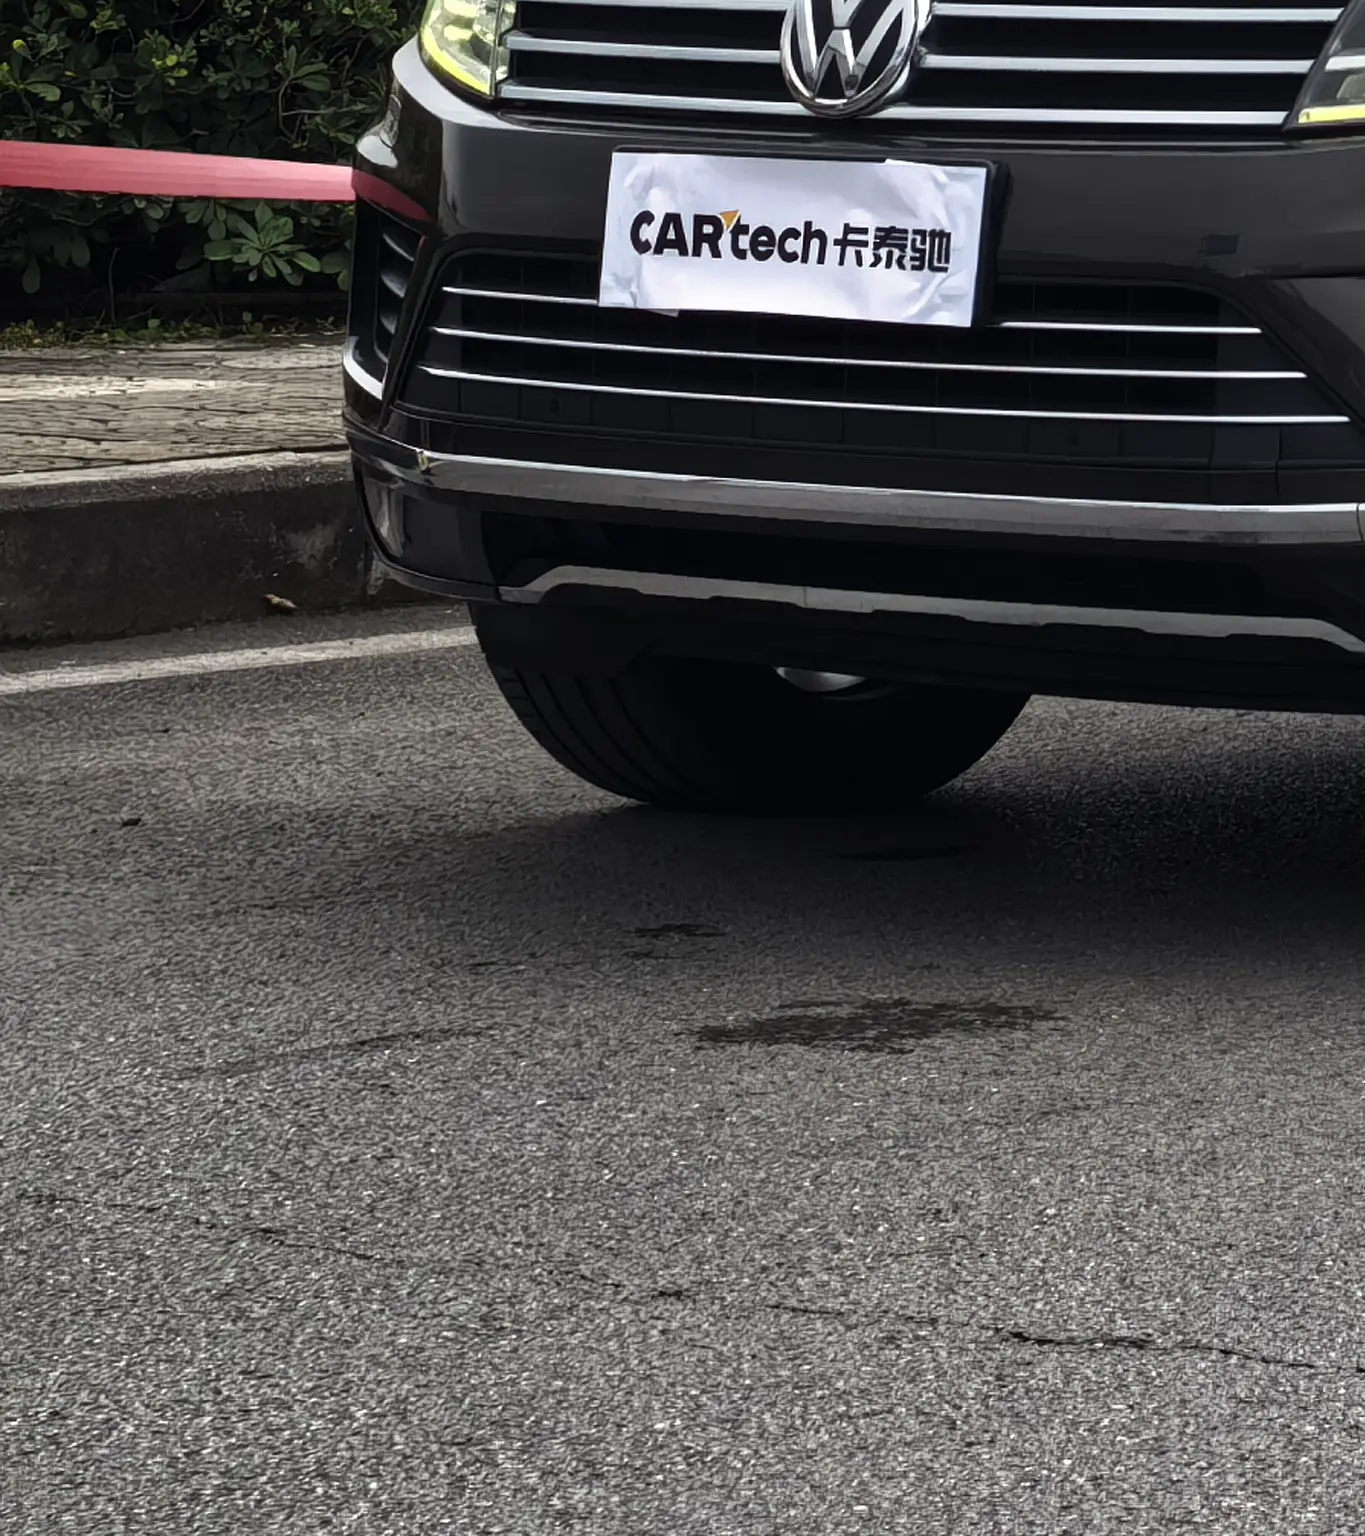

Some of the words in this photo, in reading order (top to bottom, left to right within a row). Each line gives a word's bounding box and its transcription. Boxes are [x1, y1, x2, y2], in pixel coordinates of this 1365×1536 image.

[630, 209, 827, 265] CARtech
[833, 223, 951, 272] 卡泰驰
